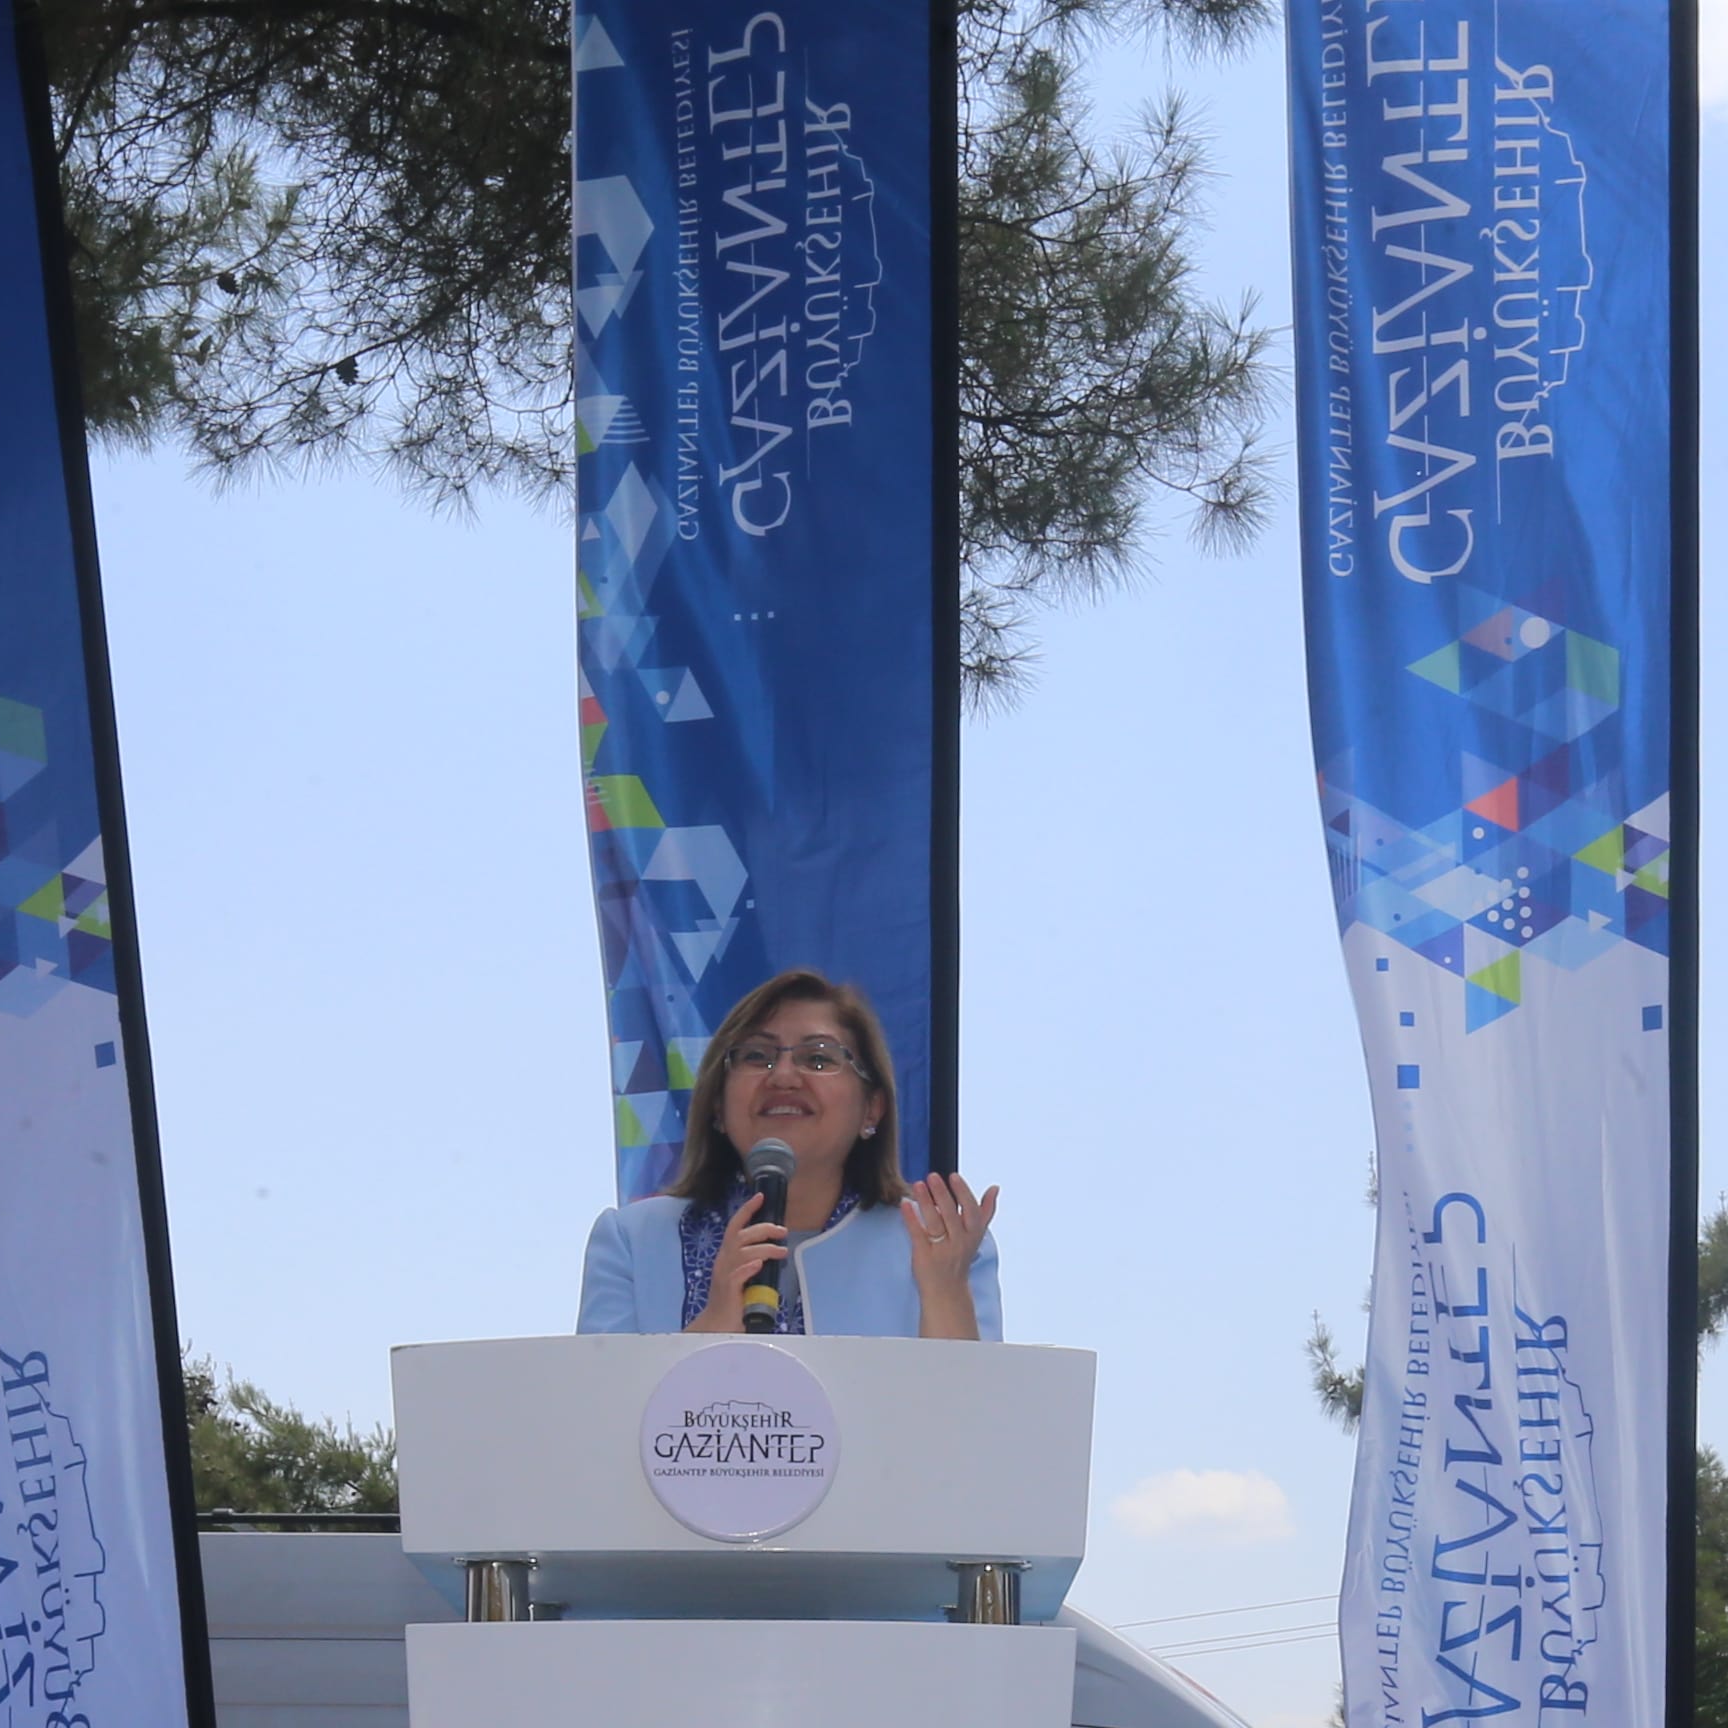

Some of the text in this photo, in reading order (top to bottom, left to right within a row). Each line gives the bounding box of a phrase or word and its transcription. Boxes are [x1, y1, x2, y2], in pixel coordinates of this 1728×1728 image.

[684, 1410, 792, 1432] BÜYÜKŞEHİR
[654, 1428, 825, 1464] GAZİANTEP
[654, 1467, 707, 1477] GAZİANTEP
